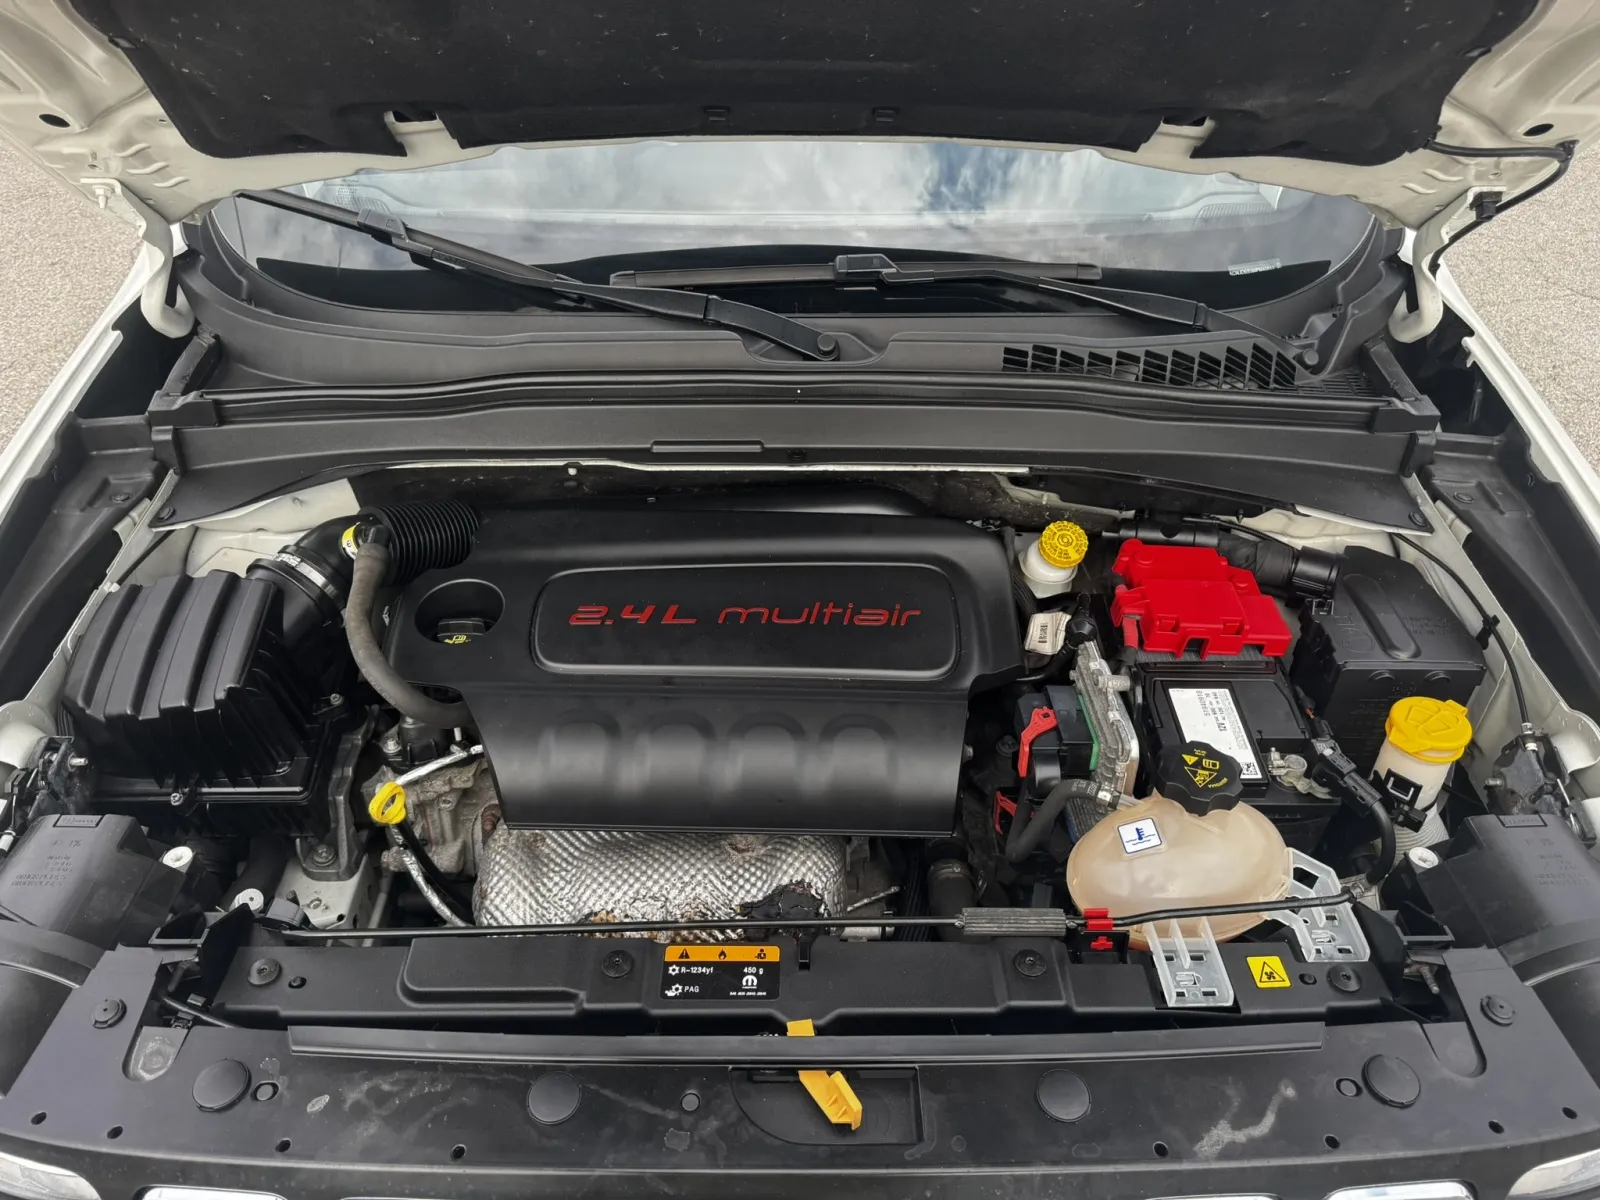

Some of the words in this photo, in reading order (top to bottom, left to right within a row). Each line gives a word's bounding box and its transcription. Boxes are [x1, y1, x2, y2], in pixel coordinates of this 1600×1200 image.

[717, 601, 922, 626] multiair
[680, 966, 714, 975] R-1234yf
[743, 966, 757, 974] 450
[684, 985, 700, 993] PAG
